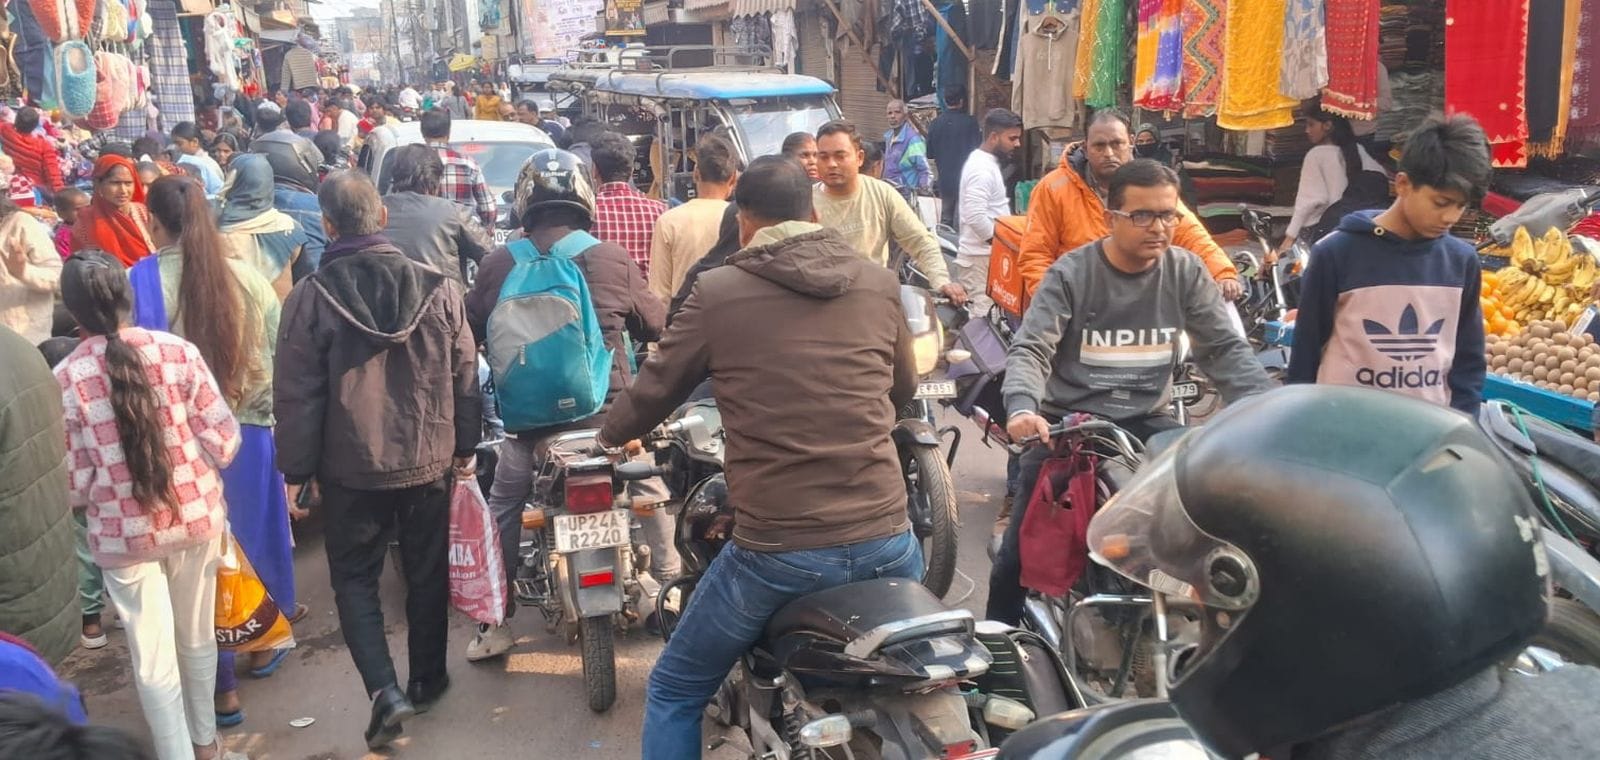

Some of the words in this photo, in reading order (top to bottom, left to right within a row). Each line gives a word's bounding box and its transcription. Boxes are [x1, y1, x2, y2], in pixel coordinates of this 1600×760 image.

[1082, 327, 1177, 347] INPUT
[1355, 365, 1441, 389] adida
[568, 513, 620, 531] UP24A
[570, 529, 621, 549] R2240
[216, 618, 262, 642] STAR
